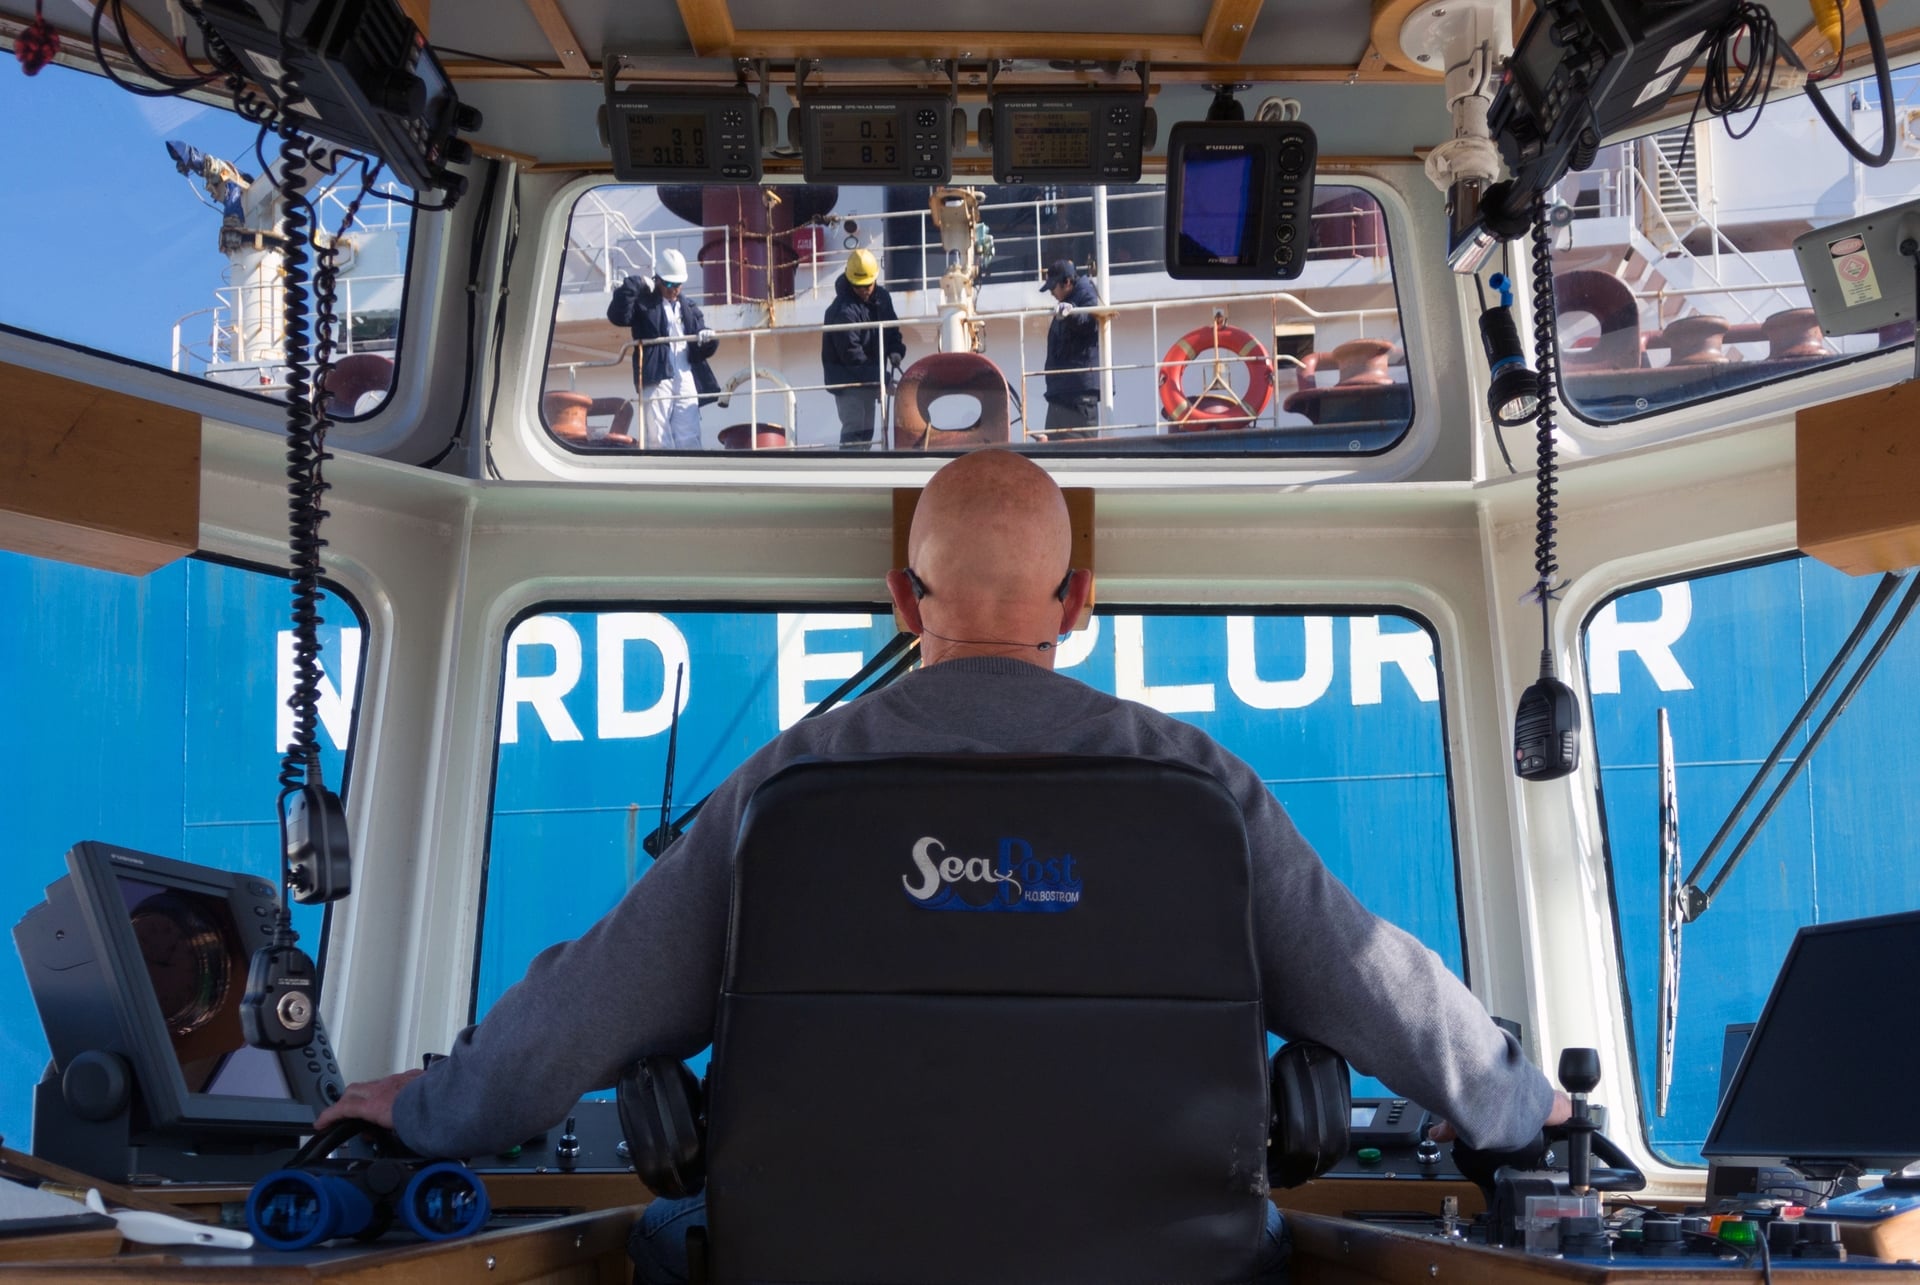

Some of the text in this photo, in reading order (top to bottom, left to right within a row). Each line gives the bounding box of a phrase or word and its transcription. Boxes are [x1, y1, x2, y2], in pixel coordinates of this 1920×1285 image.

[671, 127, 704, 147] 3.0
[860, 120, 895, 139] 0.1
[860, 145, 896, 164] 8.3
[276, 611, 691, 752] NRD
